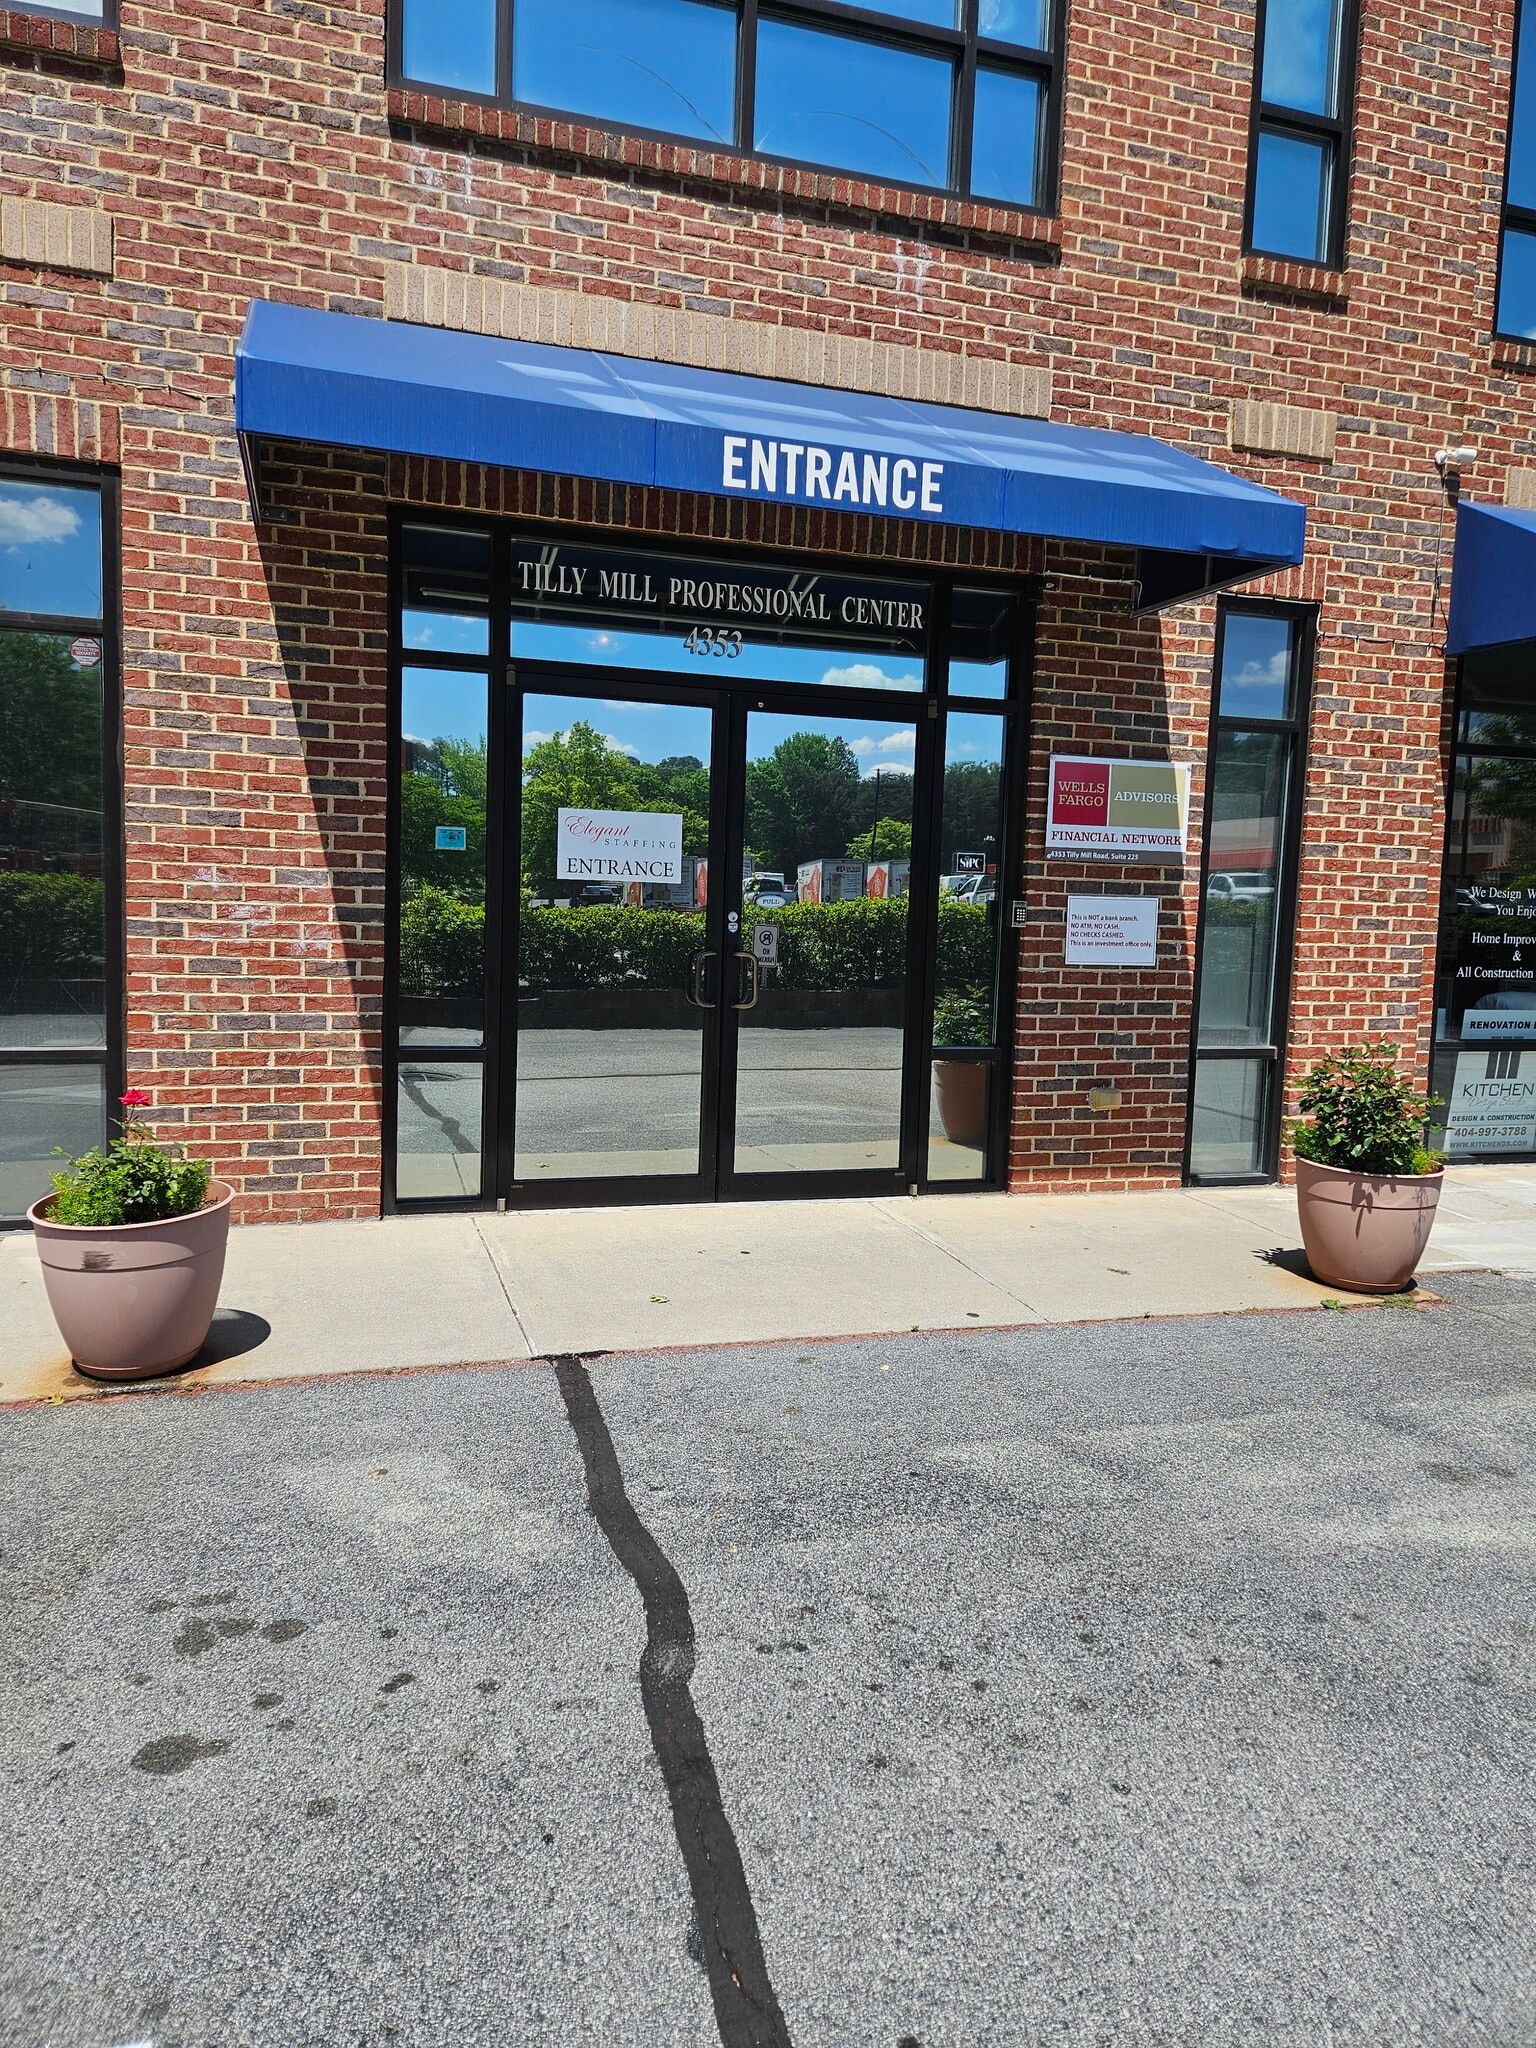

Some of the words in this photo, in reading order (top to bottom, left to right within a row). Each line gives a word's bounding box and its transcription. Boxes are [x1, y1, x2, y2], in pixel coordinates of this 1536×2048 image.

[723, 435, 944, 512] ENTRANCE
[519, 561, 587, 594] TILLY
[600, 570, 657, 602] MILL
[670, 578, 831, 621] PROFESSIONAL
[841, 596, 923, 628] CENTER
[683, 626, 743, 658] 4353
[1058, 781, 1105, 793] WELLS
[1058, 794, 1104, 806] FARGO
[1114, 791, 1180, 803] ADVISORS
[564, 815, 630, 843] Elegant
[604, 838, 676, 848] STAFFING
[1052, 831, 1118, 842] FINANCIAL
[1122, 834, 1182, 845] NETWORK
[1067, 851, 1079, 859] Tilly
[1093, 852, 1110, 860] Road,
[567, 858, 674, 877] ENTRANCE
[1471, 886, 1486, 897] We
[1489, 887, 1521, 901] Design
[1496, 905, 1514, 915] You
[1472, 932, 1500, 943] Home
[1503, 933, 1536, 947] Improv
[1513, 950, 1521, 961] &
[1456, 966, 1471, 978] All
[1474, 966, 1533, 978] Construction
[1470, 1021, 1531, 1029] RENOVATION
[1463, 1083, 1534, 1096] KITCHEN
[1468, 1097, 1497, 1112] Design
[1455, 1127, 1527, 1137] 404-997-3788
